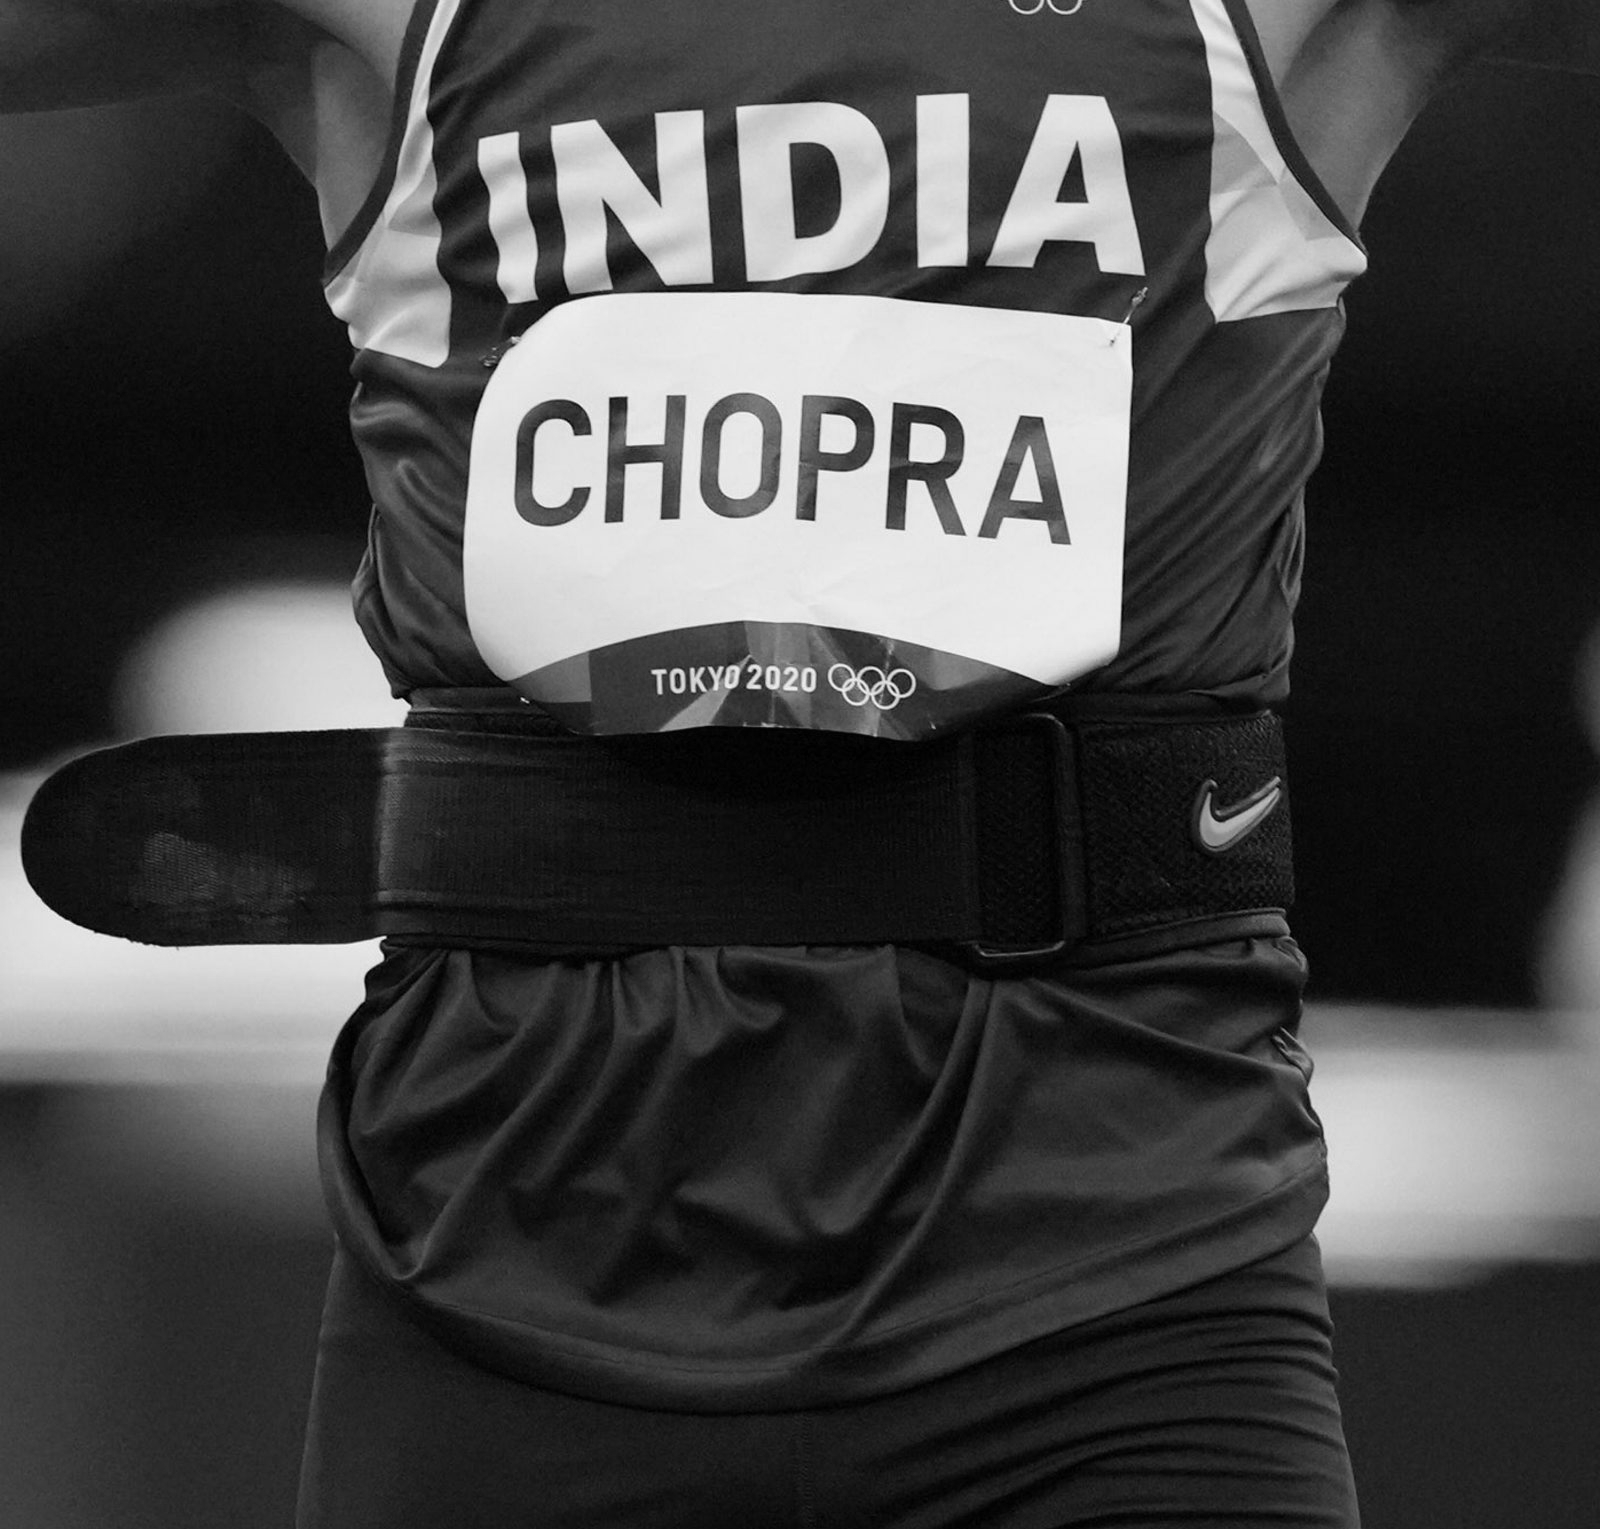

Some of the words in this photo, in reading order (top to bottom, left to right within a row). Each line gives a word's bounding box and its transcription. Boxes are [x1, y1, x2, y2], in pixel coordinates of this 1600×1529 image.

[477, 92, 1146, 304] INDIA
[513, 392, 1072, 546] CHOPRA
[651, 663, 741, 695] TOKYO
[745, 663, 818, 693] 2020
